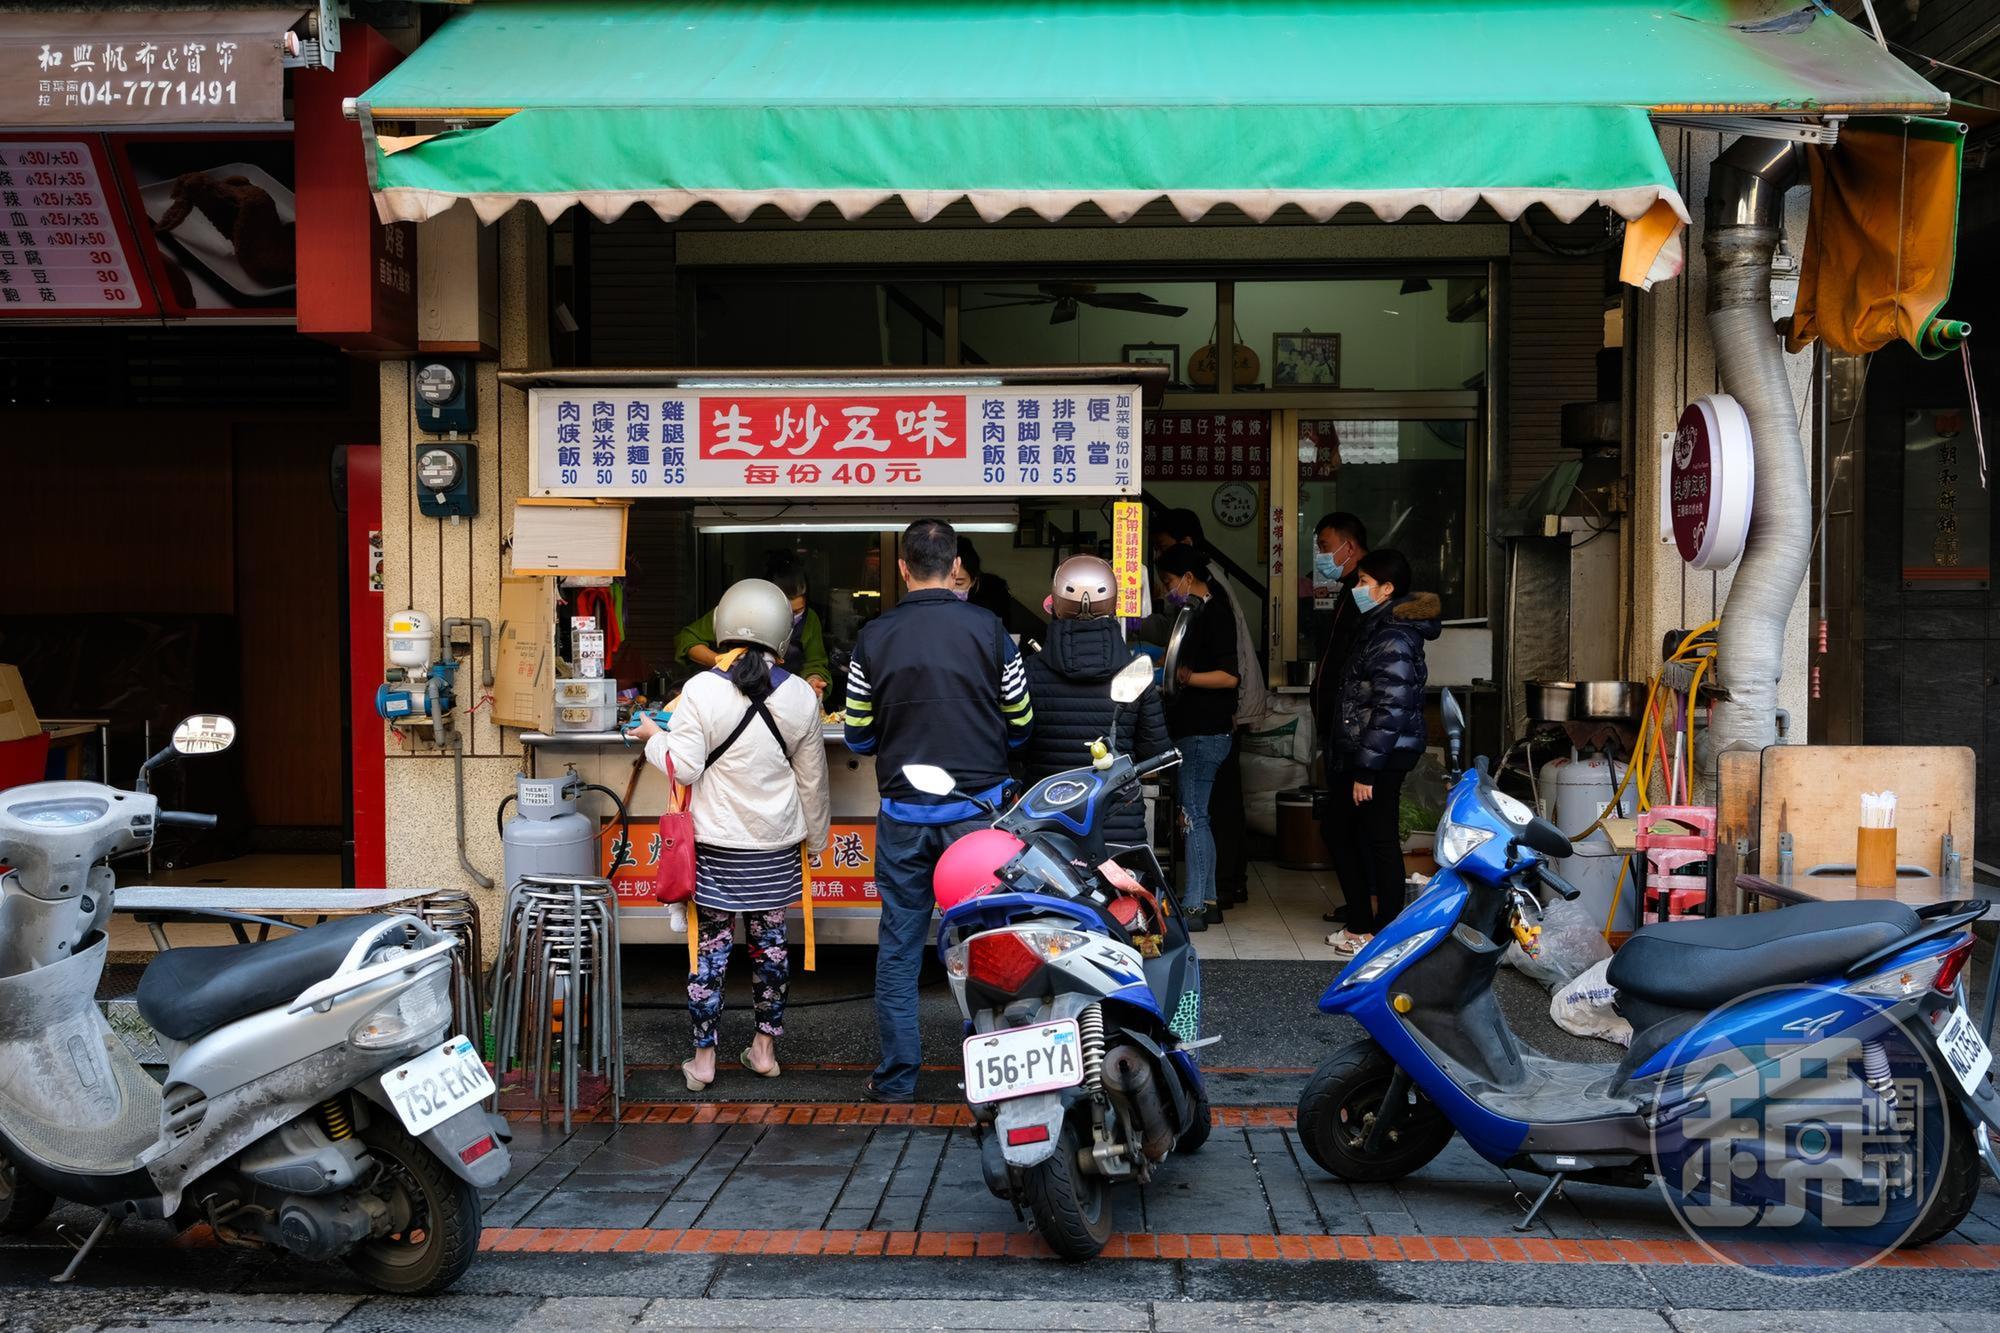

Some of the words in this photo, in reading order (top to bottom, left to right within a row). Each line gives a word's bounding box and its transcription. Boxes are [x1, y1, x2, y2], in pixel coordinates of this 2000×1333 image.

[80, 80, 237, 106] 04-7771491
[19, 151, 79, 165] 小30/大50
[26, 171, 86, 186] 小25/大35
[33, 192, 93, 206] 小25/大35
[40, 212, 99, 227] 小25/大35
[47, 232, 106, 246] 小30/大50
[90, 251, 112, 264] 30
[97, 270, 119, 283] 30
[103, 288, 126, 301] 50
[662, 401, 685, 467] 雞腿飯
[709, 401, 956, 456] 生炒五味
[982, 399, 1006, 465] 焢肉飯
[1052, 399, 1076, 465] 排骨飯
[1087, 398, 1111, 465] 便當
[1115, 395, 1130, 485] 加菜每份10元
[561, 469, 578, 484] 50
[597, 469, 613, 484] 50
[631, 469, 647, 484] 50
[664, 468, 685, 484] 55
[983, 467, 1005, 483] 50
[1019, 467, 1039, 483] 70
[1053, 467, 1076, 483] 55
